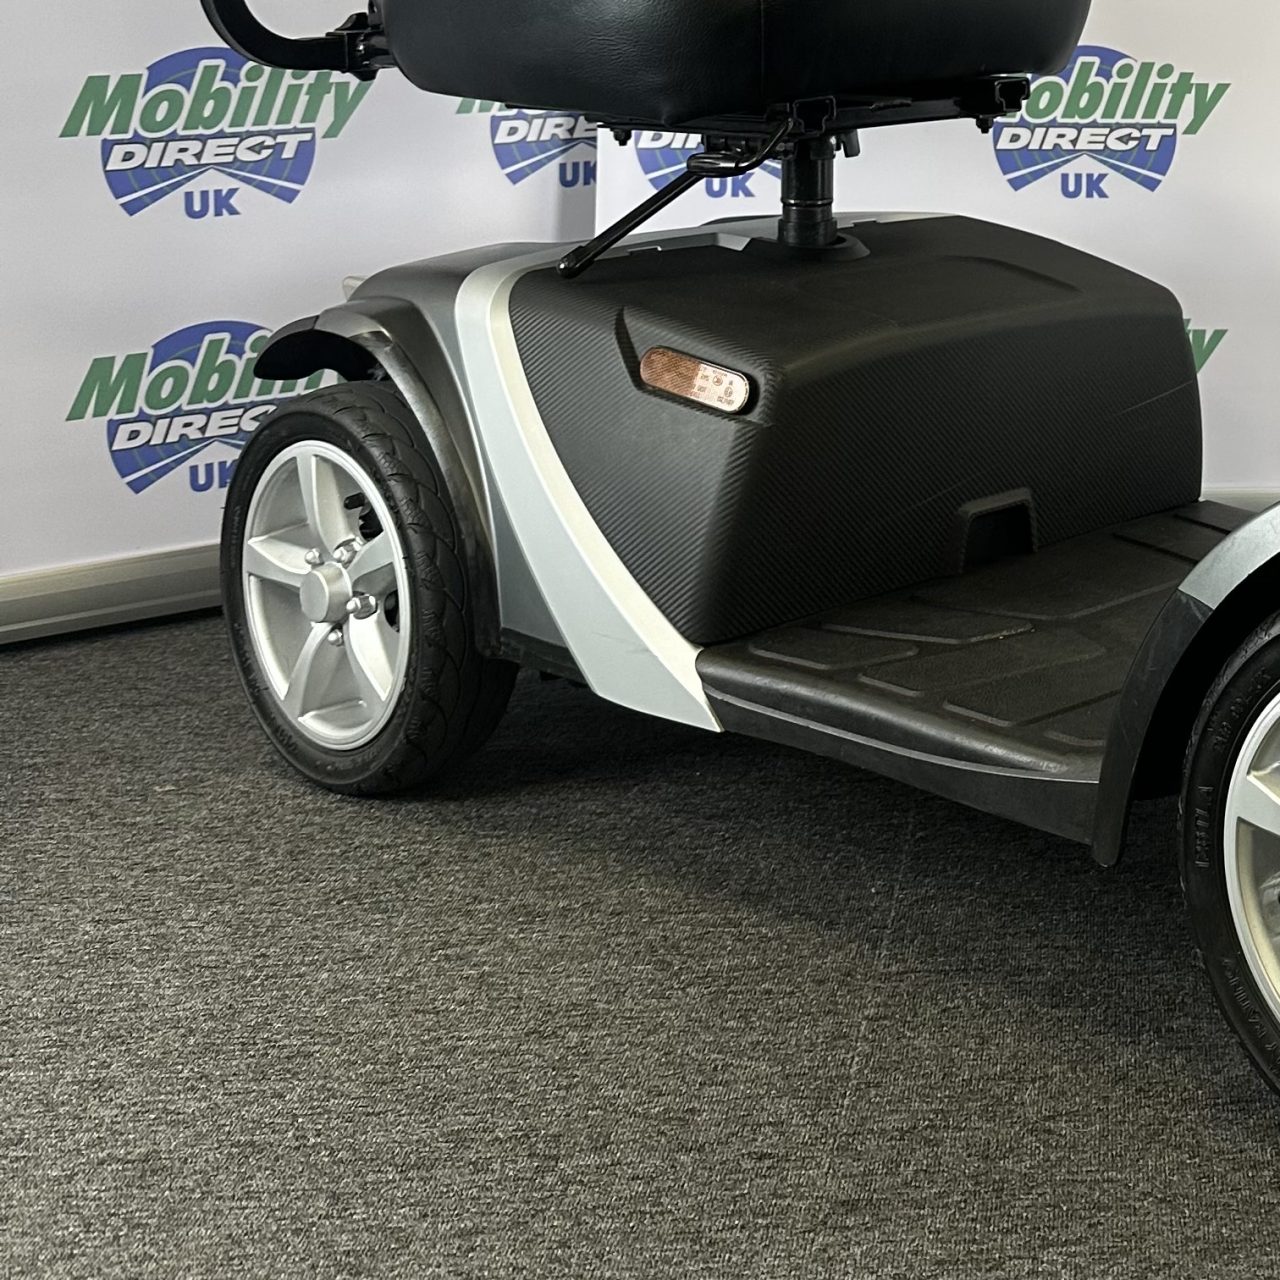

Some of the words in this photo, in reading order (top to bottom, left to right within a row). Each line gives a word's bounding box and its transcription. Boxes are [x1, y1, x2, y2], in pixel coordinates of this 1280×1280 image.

[58, 60, 374, 139] Mobility
[1003, 62, 1231, 135] obility
[106, 134, 311, 169] DIRECT
[996, 127, 1174, 151] DIRECT
[1060, 173, 1109, 199] UK
[184, 189, 240, 219] UK
[112, 404, 277, 450] DIREC
